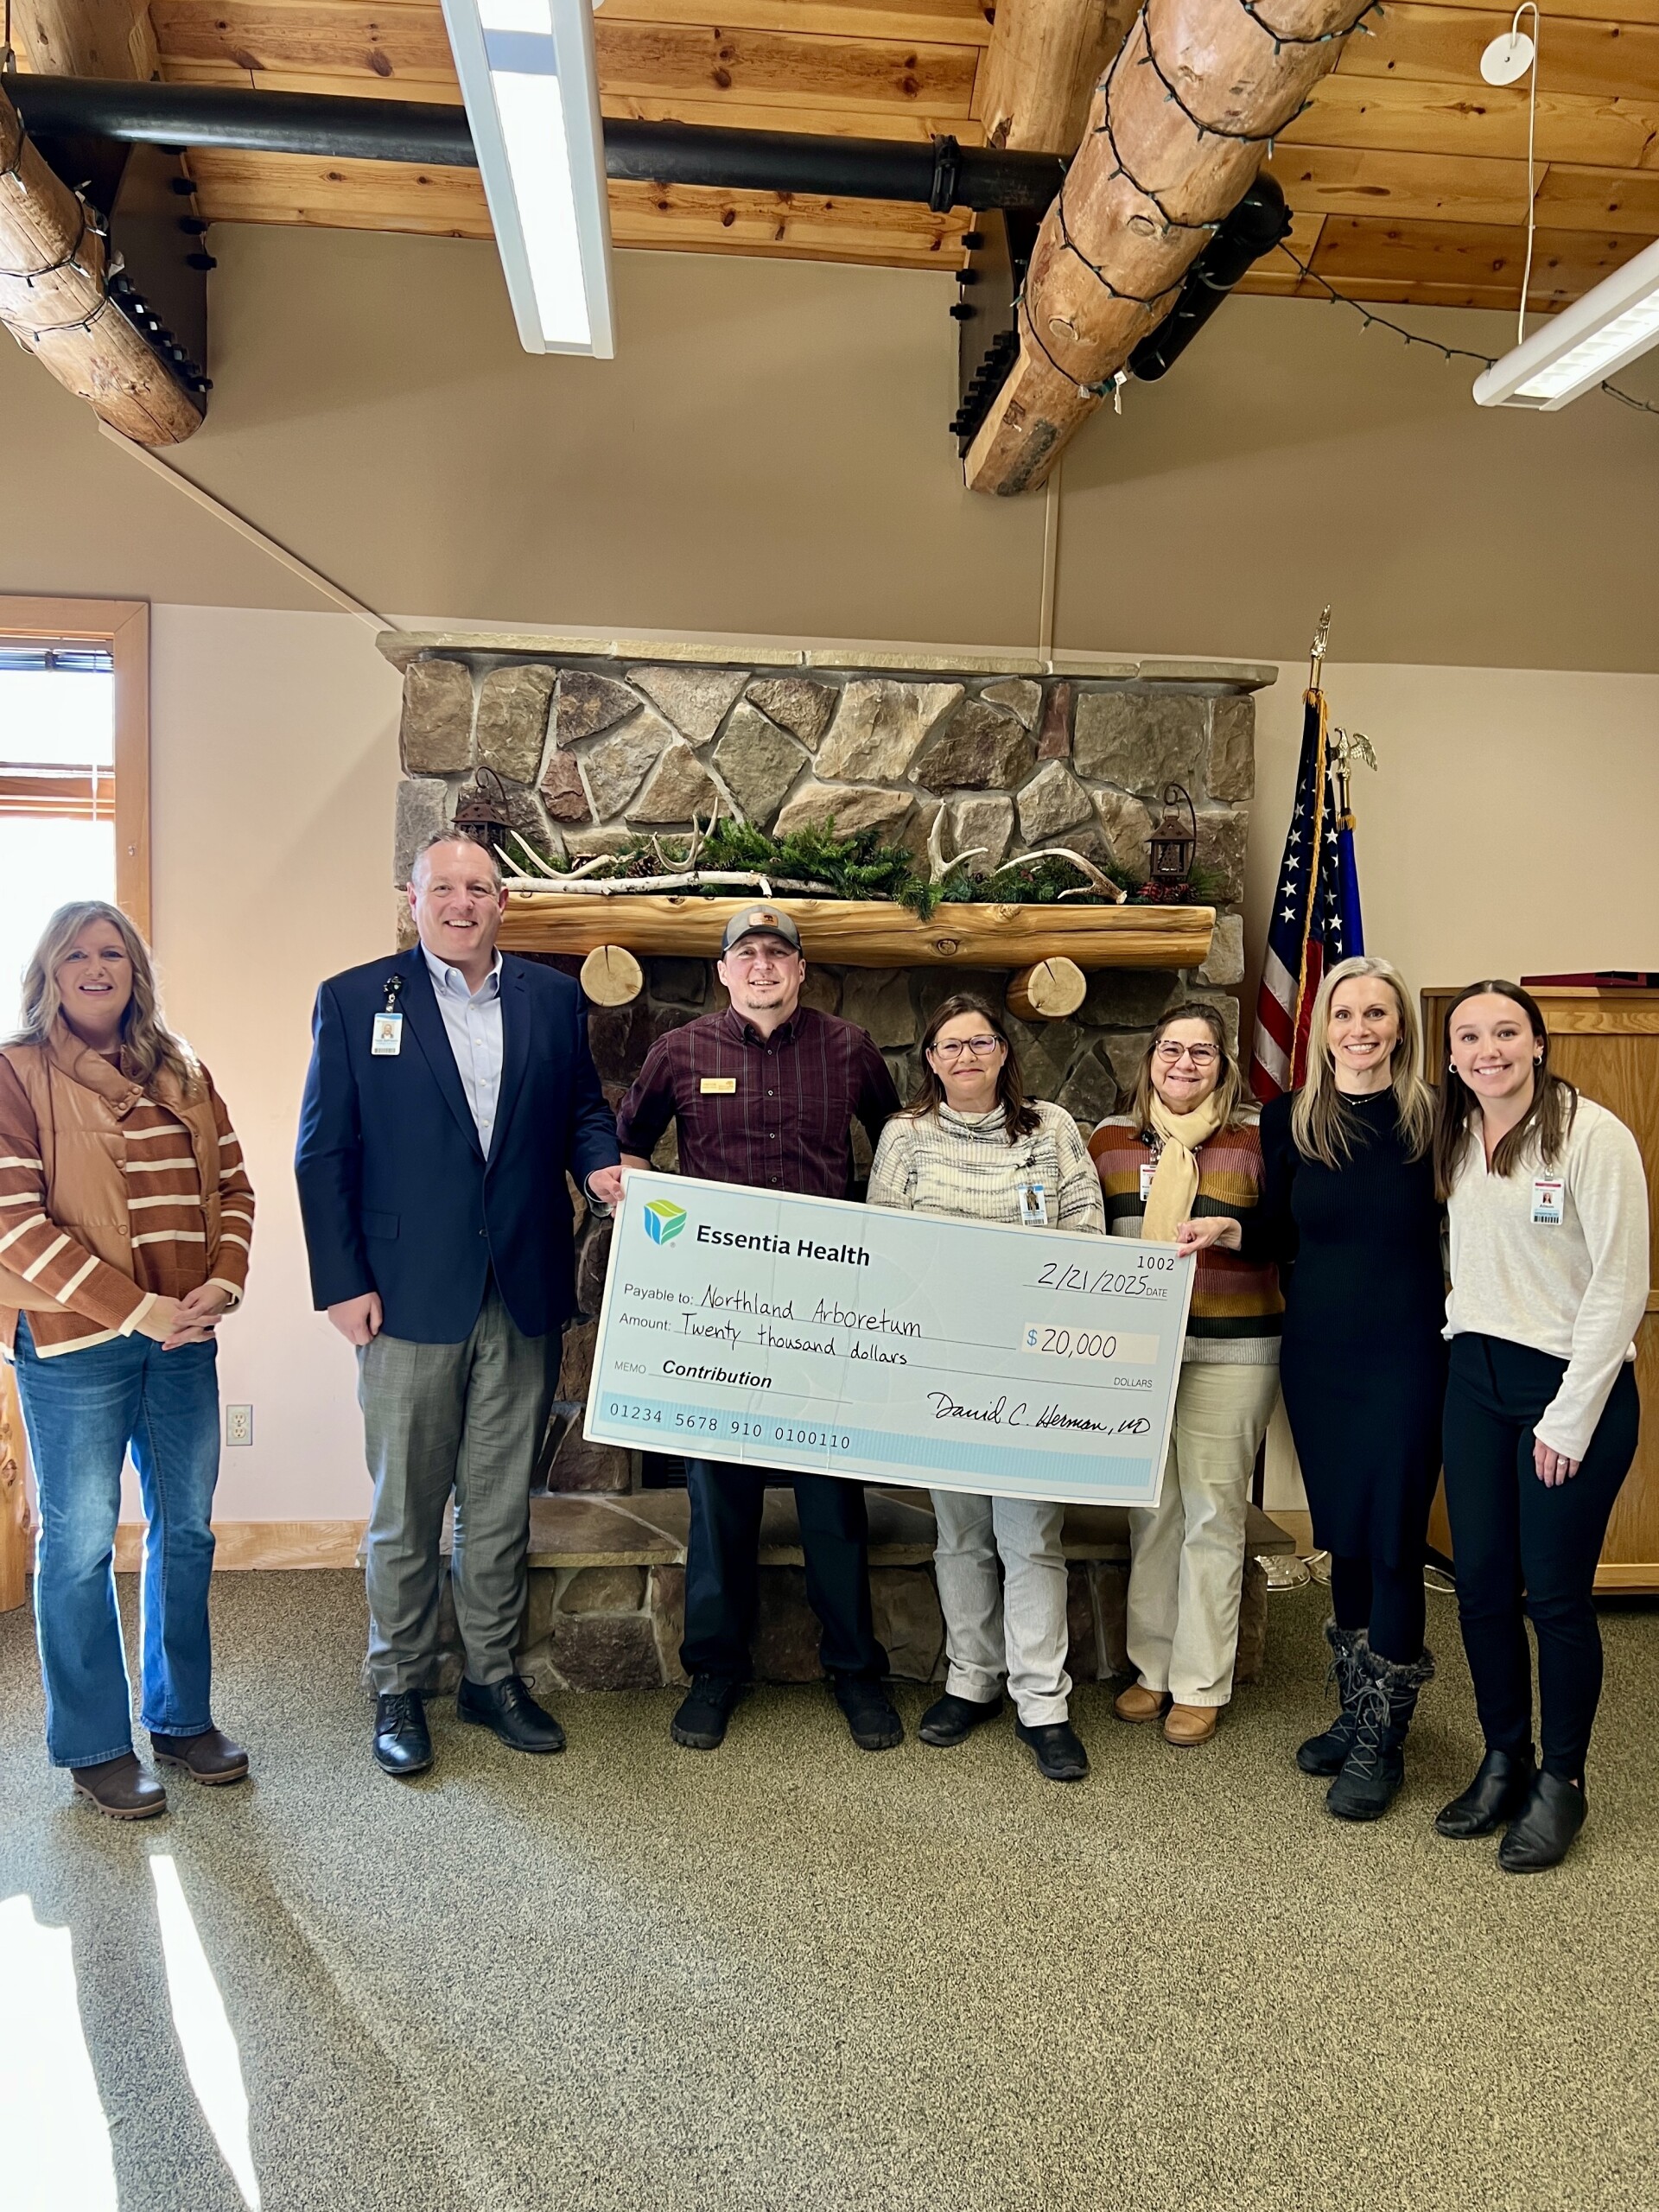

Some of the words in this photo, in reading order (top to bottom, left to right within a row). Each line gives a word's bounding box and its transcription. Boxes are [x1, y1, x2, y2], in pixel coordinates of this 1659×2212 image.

[696, 1224, 791, 1255] Essentia
[797, 1239, 870, 1266] Health
[1038, 1262, 1147, 1296] 2/21/2025
[1137, 1255, 1174, 1271] 1002
[1146, 1287, 1168, 1298] DATE
[624, 1283, 674, 1302] Payable
[678, 1291, 694, 1306] to:
[701, 1284, 794, 1320] Northland
[811, 1298, 921, 1338] Arboretum
[619, 1313, 671, 1332] Amount:
[682, 1313, 741, 1350] Twenty
[757, 1323, 836, 1356] thousand
[850, 1337, 907, 1365] dollars
[614, 1361, 646, 1374] MEMO
[662, 1360, 772, 1389] Contribution
[1114, 1376, 1153, 1389] DOLLARS
[609, 1402, 663, 1423] 01234
[675, 1413, 718, 1431] 5678
[730, 1421, 762, 1438] 910
[774, 1427, 850, 1449] 0100110
